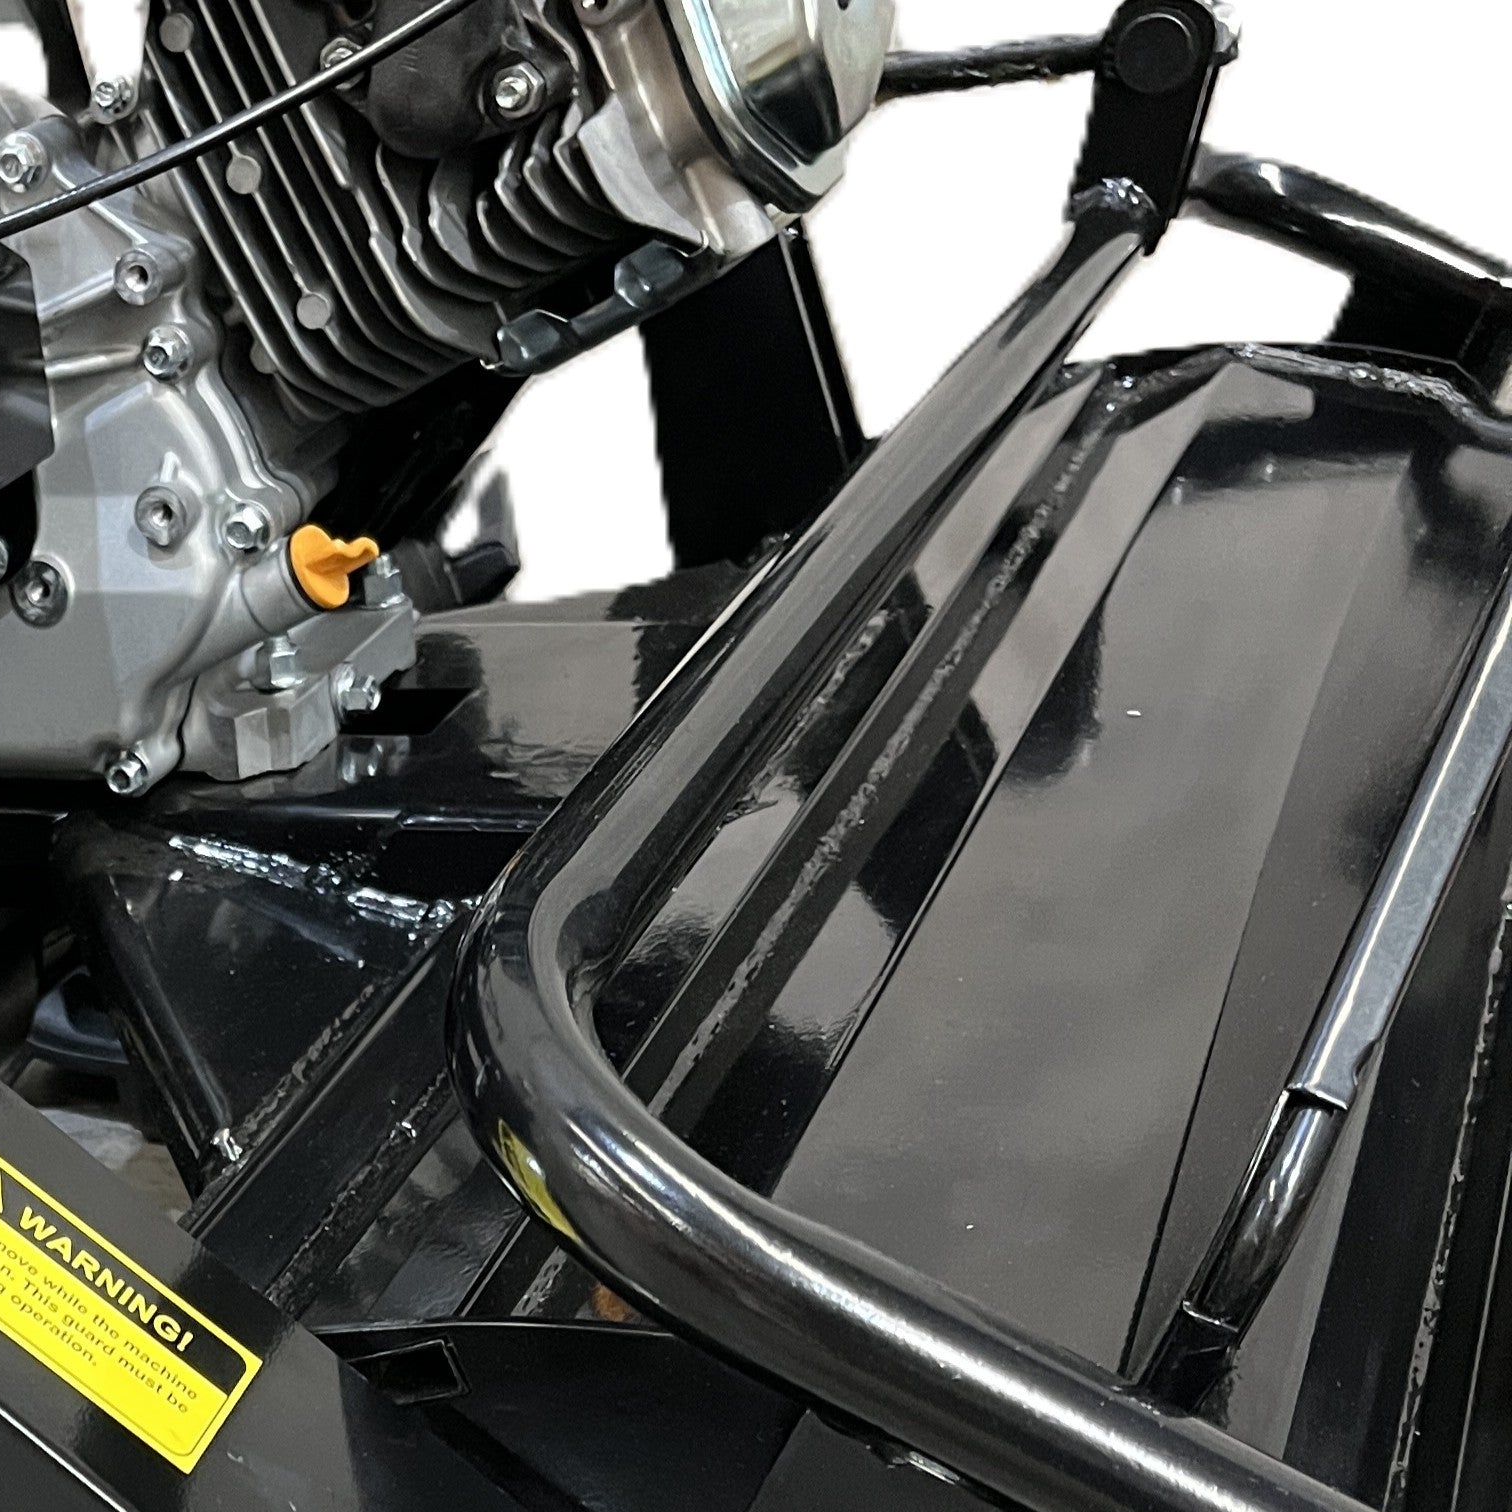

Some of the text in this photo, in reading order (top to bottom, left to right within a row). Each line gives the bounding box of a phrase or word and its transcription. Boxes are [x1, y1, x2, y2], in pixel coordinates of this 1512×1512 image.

[10, 1294, 98, 1367] operation.
[20, 1206, 194, 1352] WARNING!
[43, 1275, 88, 1315] while
[92, 1313, 120, 1340] the
[124, 1340, 198, 1400] machine
[23, 1277, 59, 1313] This
[62, 1314, 116, 1356] guard
[118, 1356, 163, 1394] must
[166, 1392, 189, 1414] be
